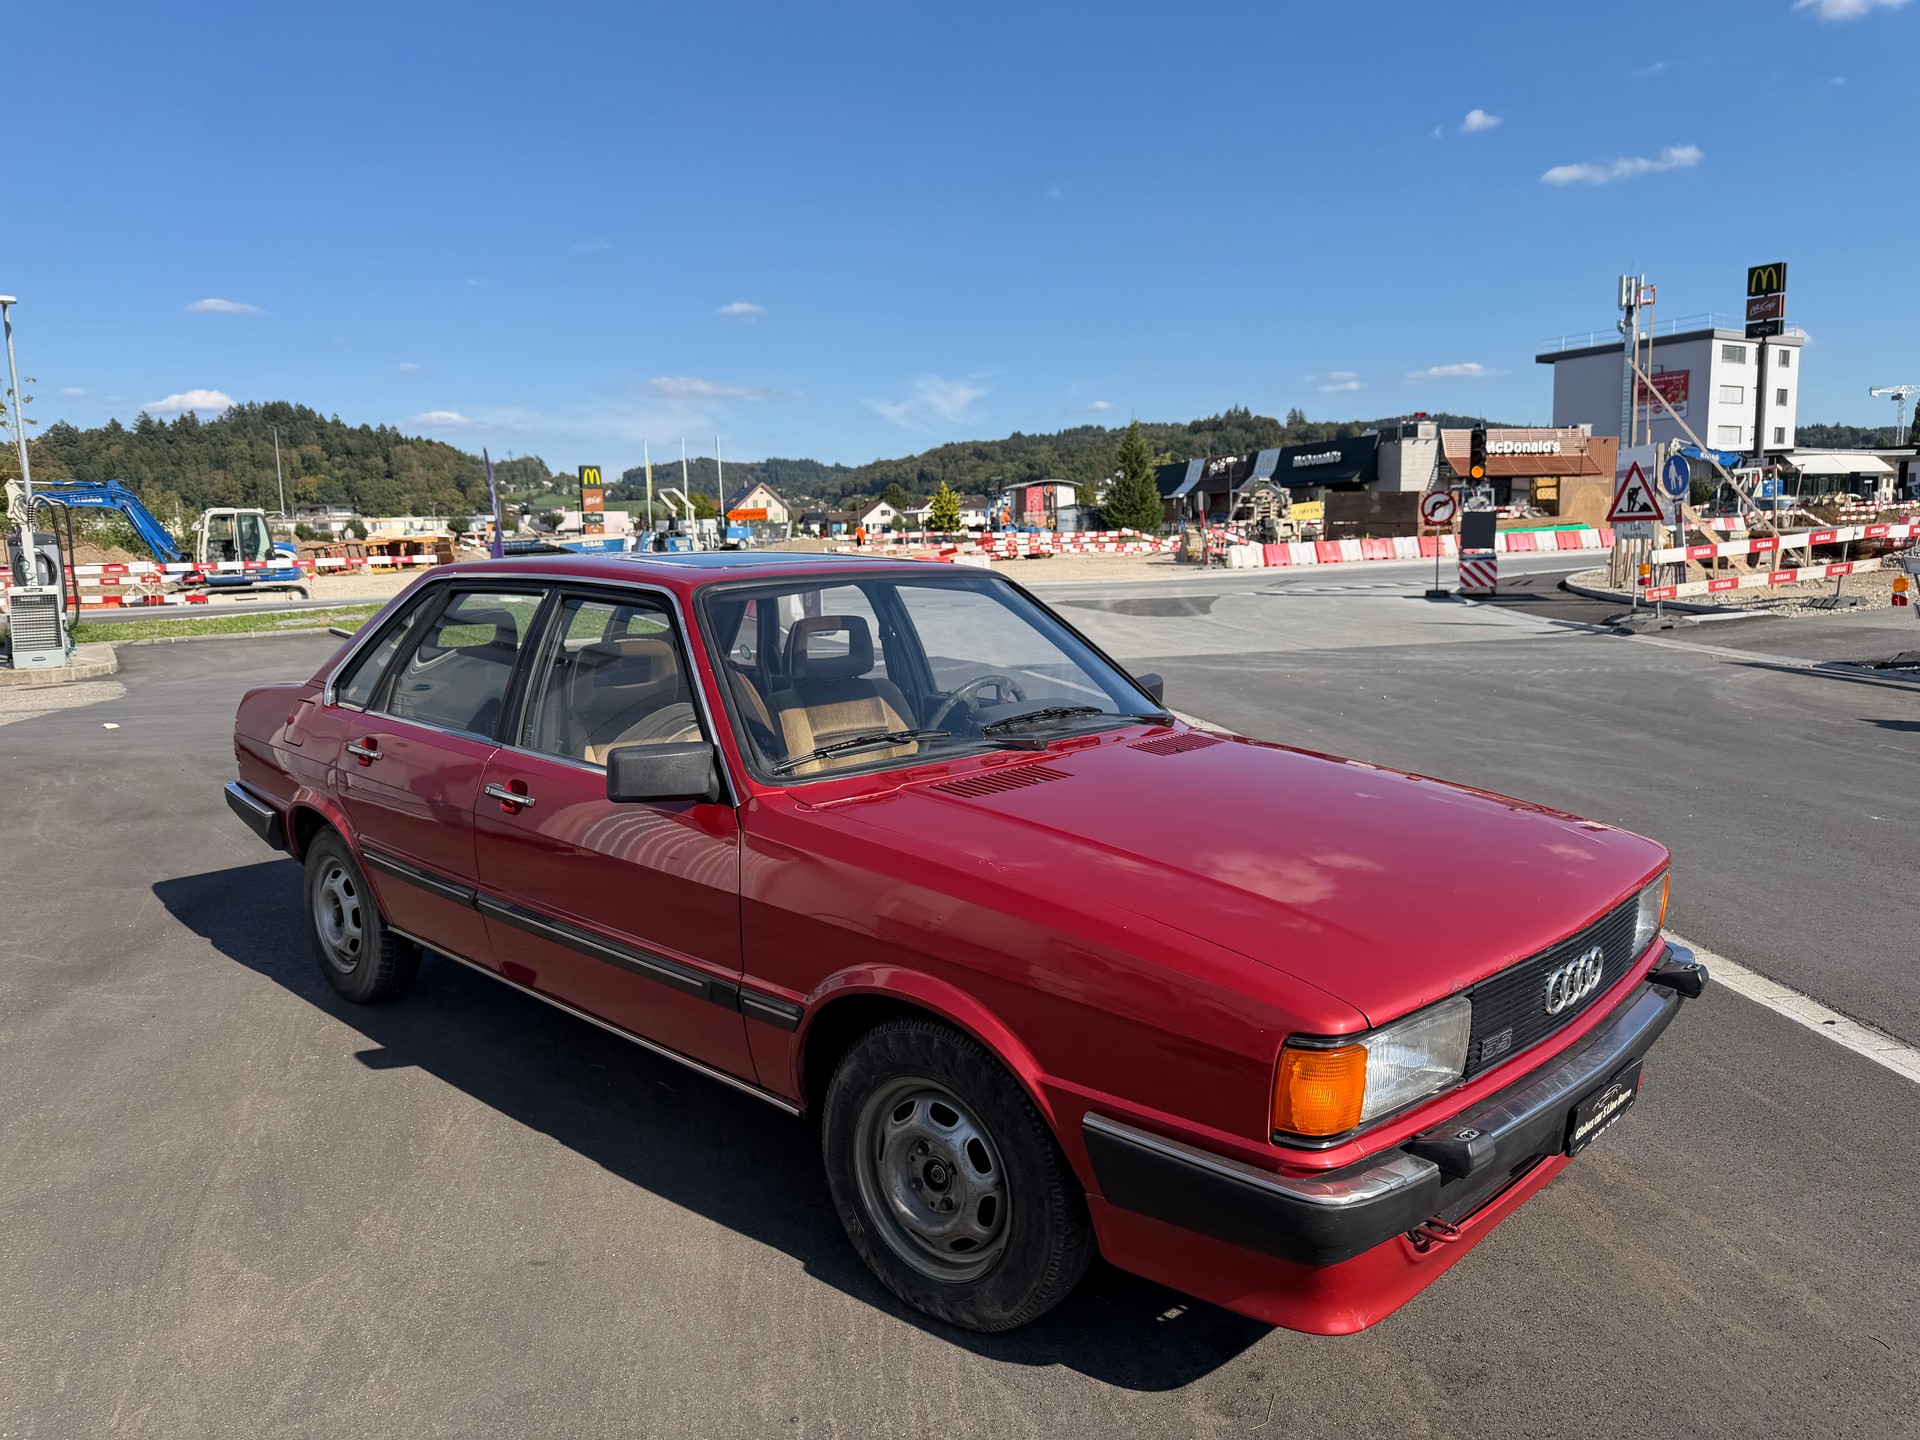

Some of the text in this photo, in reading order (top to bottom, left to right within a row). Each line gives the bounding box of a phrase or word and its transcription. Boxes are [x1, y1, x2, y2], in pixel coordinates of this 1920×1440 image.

[1486, 441, 1560, 454] McDonald's
[1757, 540, 1773, 548] KIBAG
[1694, 548, 1711, 556] KIBAG
[1715, 580, 1732, 589] KIBAG
